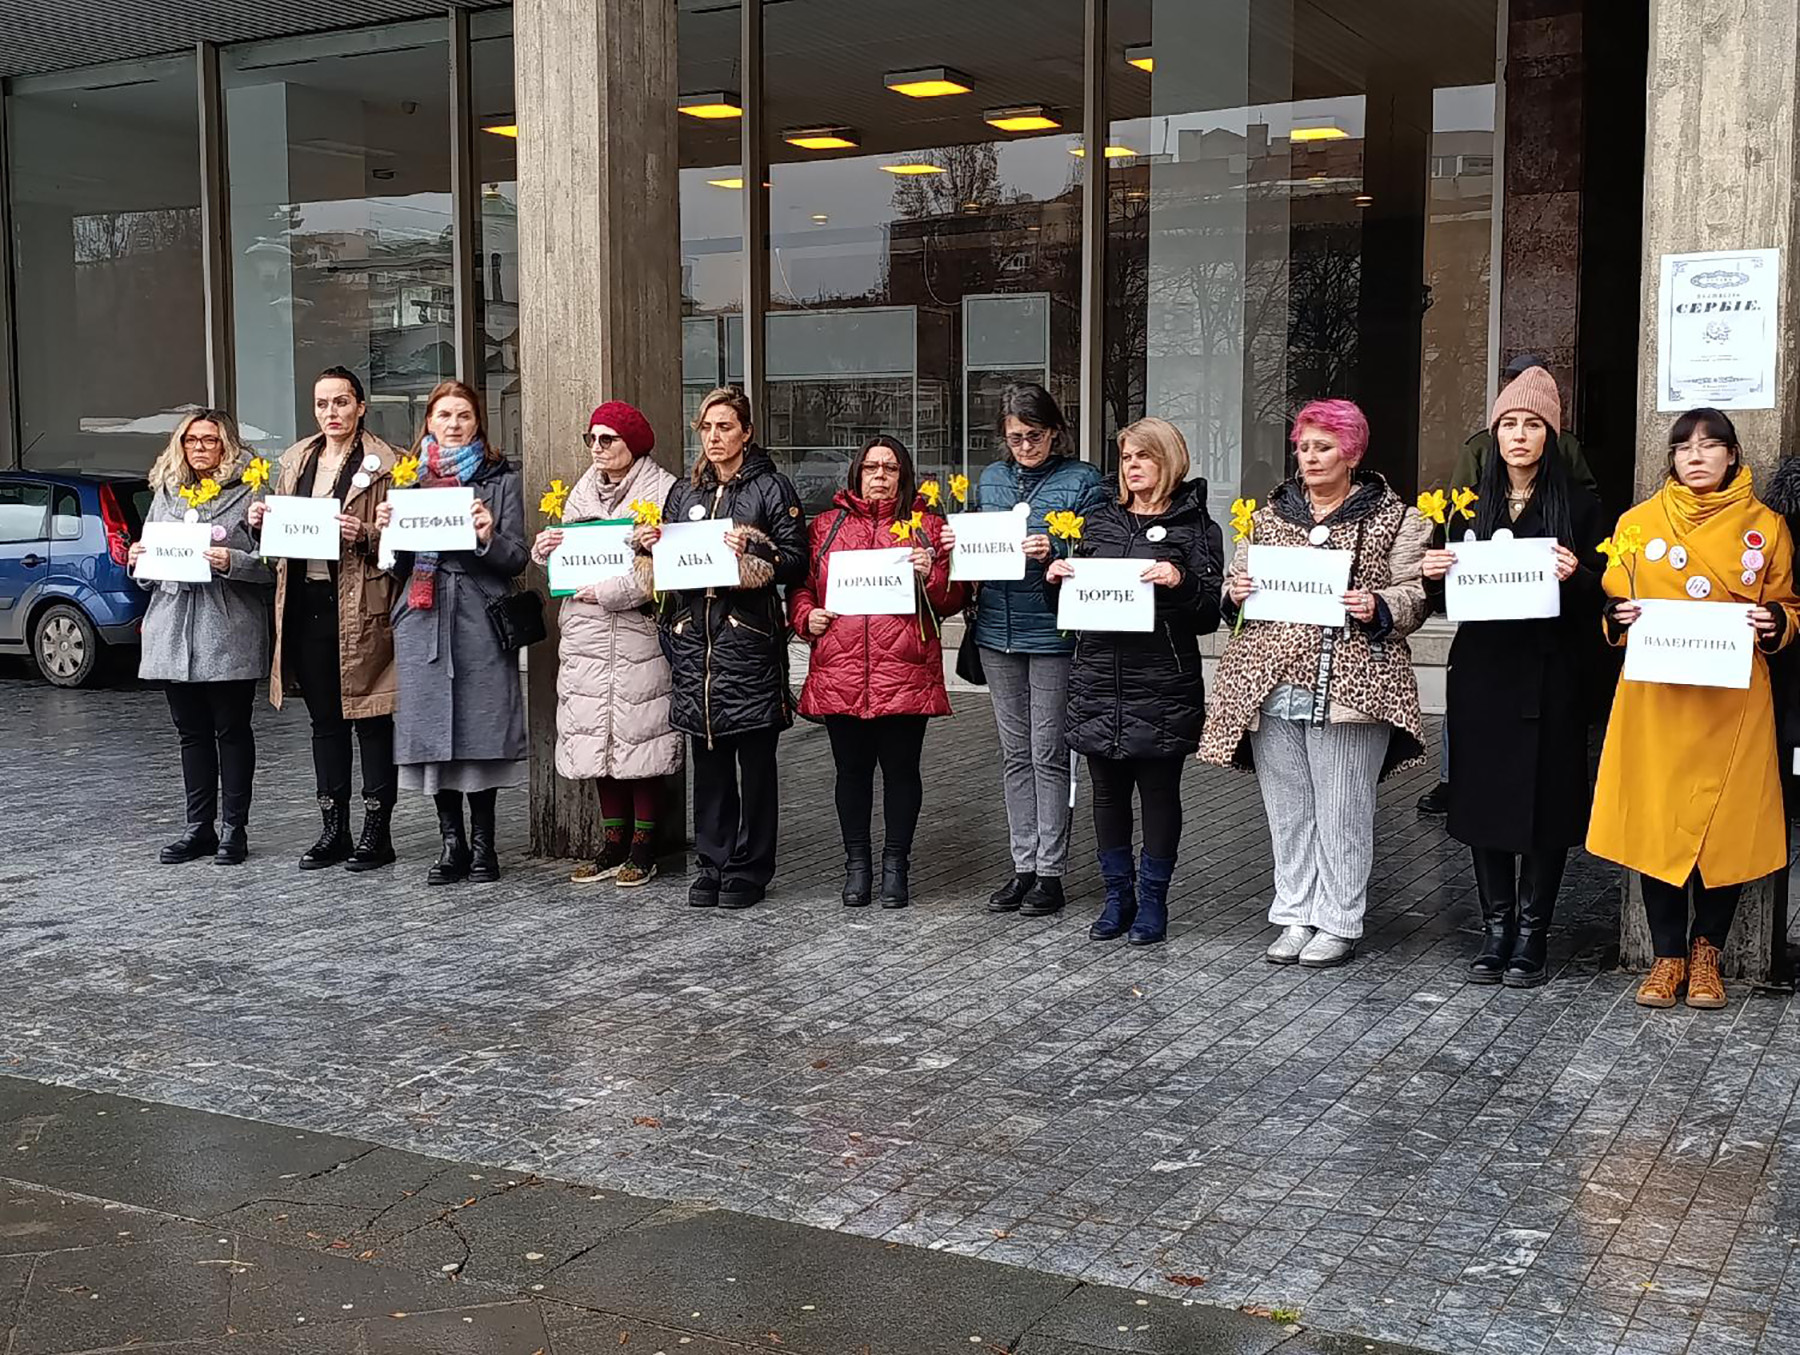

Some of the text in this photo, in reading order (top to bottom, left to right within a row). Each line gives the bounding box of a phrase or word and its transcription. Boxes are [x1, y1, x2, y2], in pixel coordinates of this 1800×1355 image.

[398, 515, 465, 529] СТЕФАН
[283, 523, 320, 536] ЂУРО
[155, 546, 194, 559] ВАСКО
[959, 542, 1016, 555] МИЛЕВА
[560, 553, 625, 567] МИЛОШ
[676, 552, 715, 567] АЊА
[1457, 570, 1545, 587] ВУКАШИН
[1260, 578, 1334, 596] МИЛИЦА
[1075, 588, 1136, 604] ЂОРЂЕ
[1322, 638, 1332, 650] IS
[1643, 635, 1737, 652] ВАЛЕНТИНА
[1313, 654, 1331, 724] BEAUTIFUL
